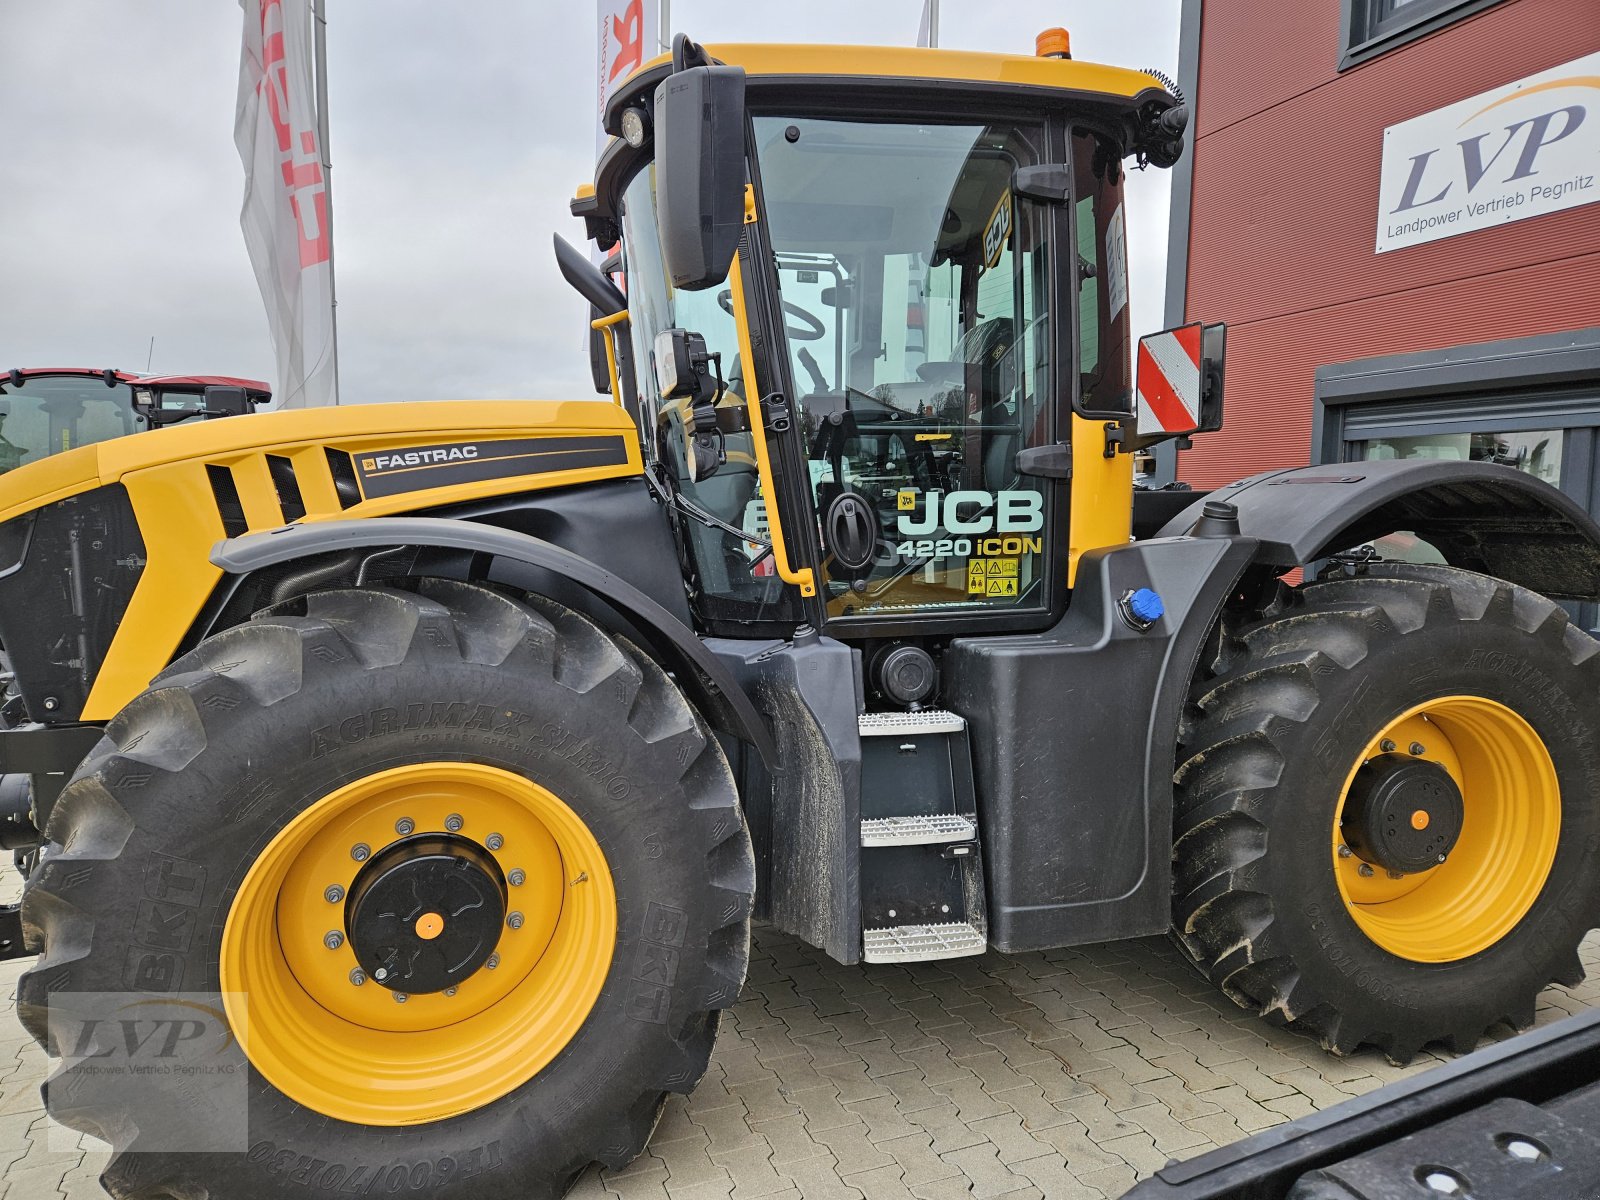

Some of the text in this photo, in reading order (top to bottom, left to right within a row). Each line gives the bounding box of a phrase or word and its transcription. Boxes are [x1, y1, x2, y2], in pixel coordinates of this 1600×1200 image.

[1389, 104, 1587, 215] LVP
[1387, 175, 1594, 238] Landpower Vertrieb Pegnitz
[376, 445, 479, 470] FASTRAC
[896, 539, 972, 558] 4220
[977, 537, 1042, 556] iCON
[897, 490, 1044, 535] JCB
[310, 701, 632, 800] AGRIMAX SIRIO
[134, 860, 197, 993] BKT
[632, 905, 683, 1020] BKT
